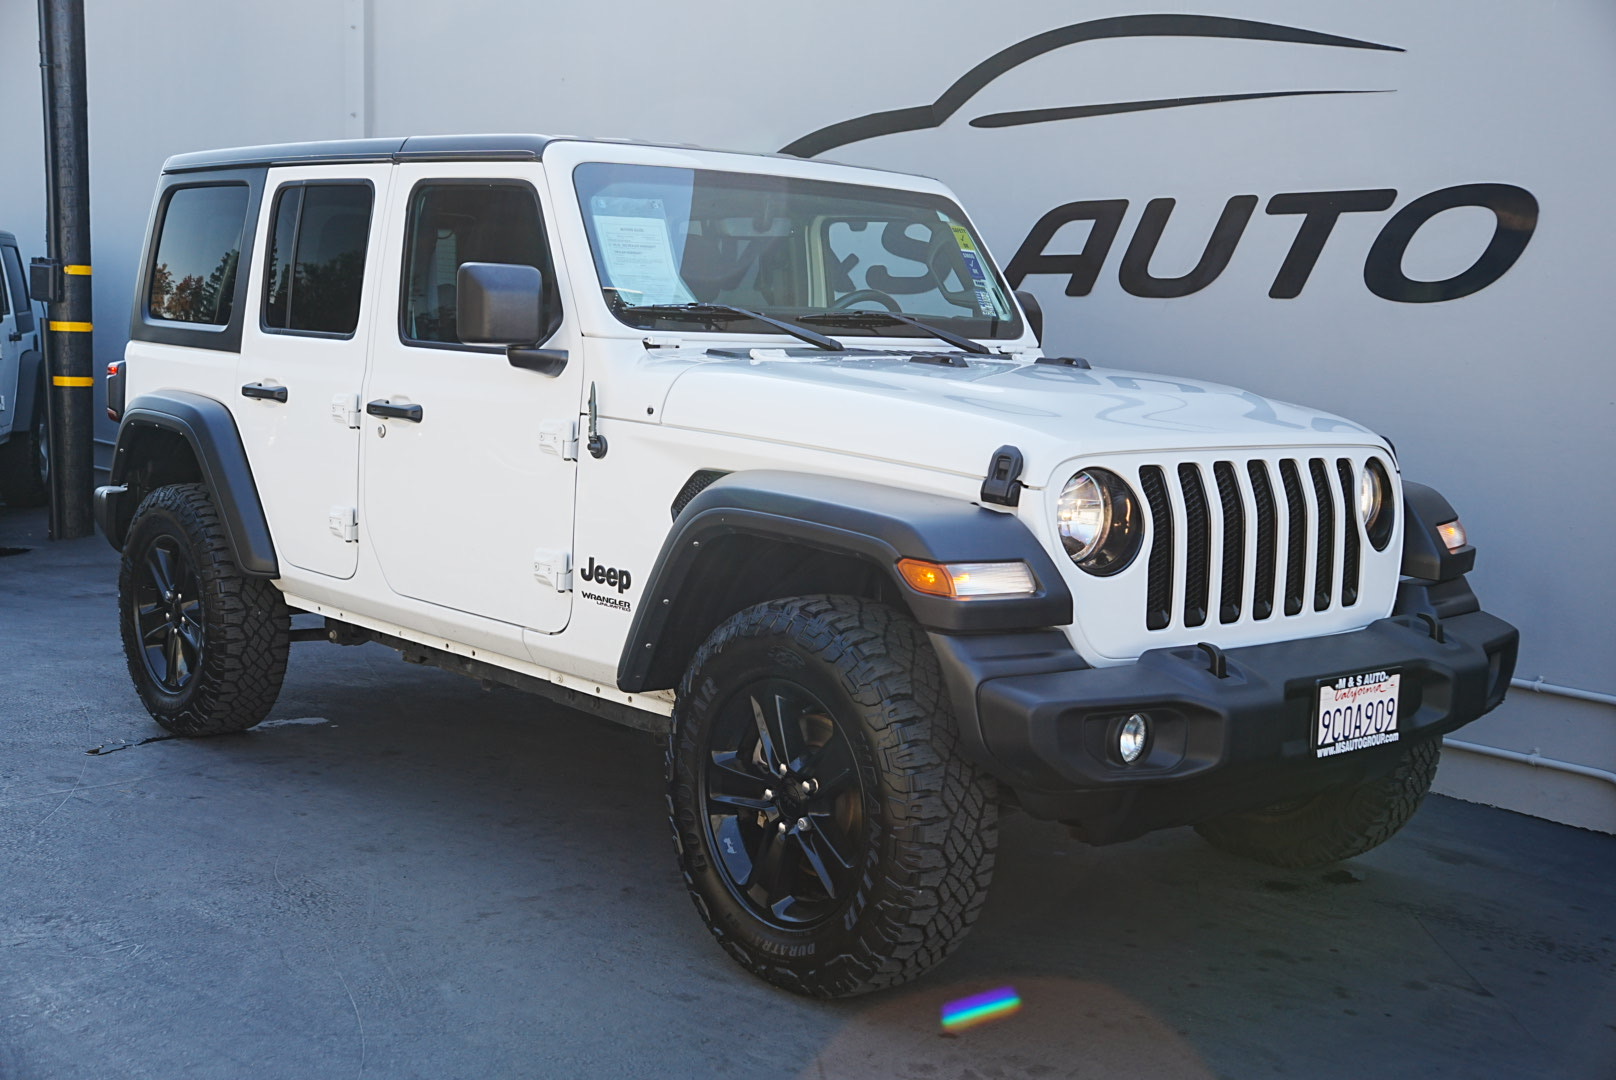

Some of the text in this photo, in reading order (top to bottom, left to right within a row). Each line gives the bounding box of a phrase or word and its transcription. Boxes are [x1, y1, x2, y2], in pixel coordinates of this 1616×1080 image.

[1003, 183, 1540, 304] AUTO
[580, 556, 632, 594] Jeep
[581, 590, 631, 609] WRANGLER
[1347, 676, 1355, 687] &
[1356, 675, 1363, 686] S
[1364, 671, 1386, 685] AUTO
[1334, 683, 1386, 703] California
[1316, 732, 1399, 758] www.MSAUTOGROUP.com
